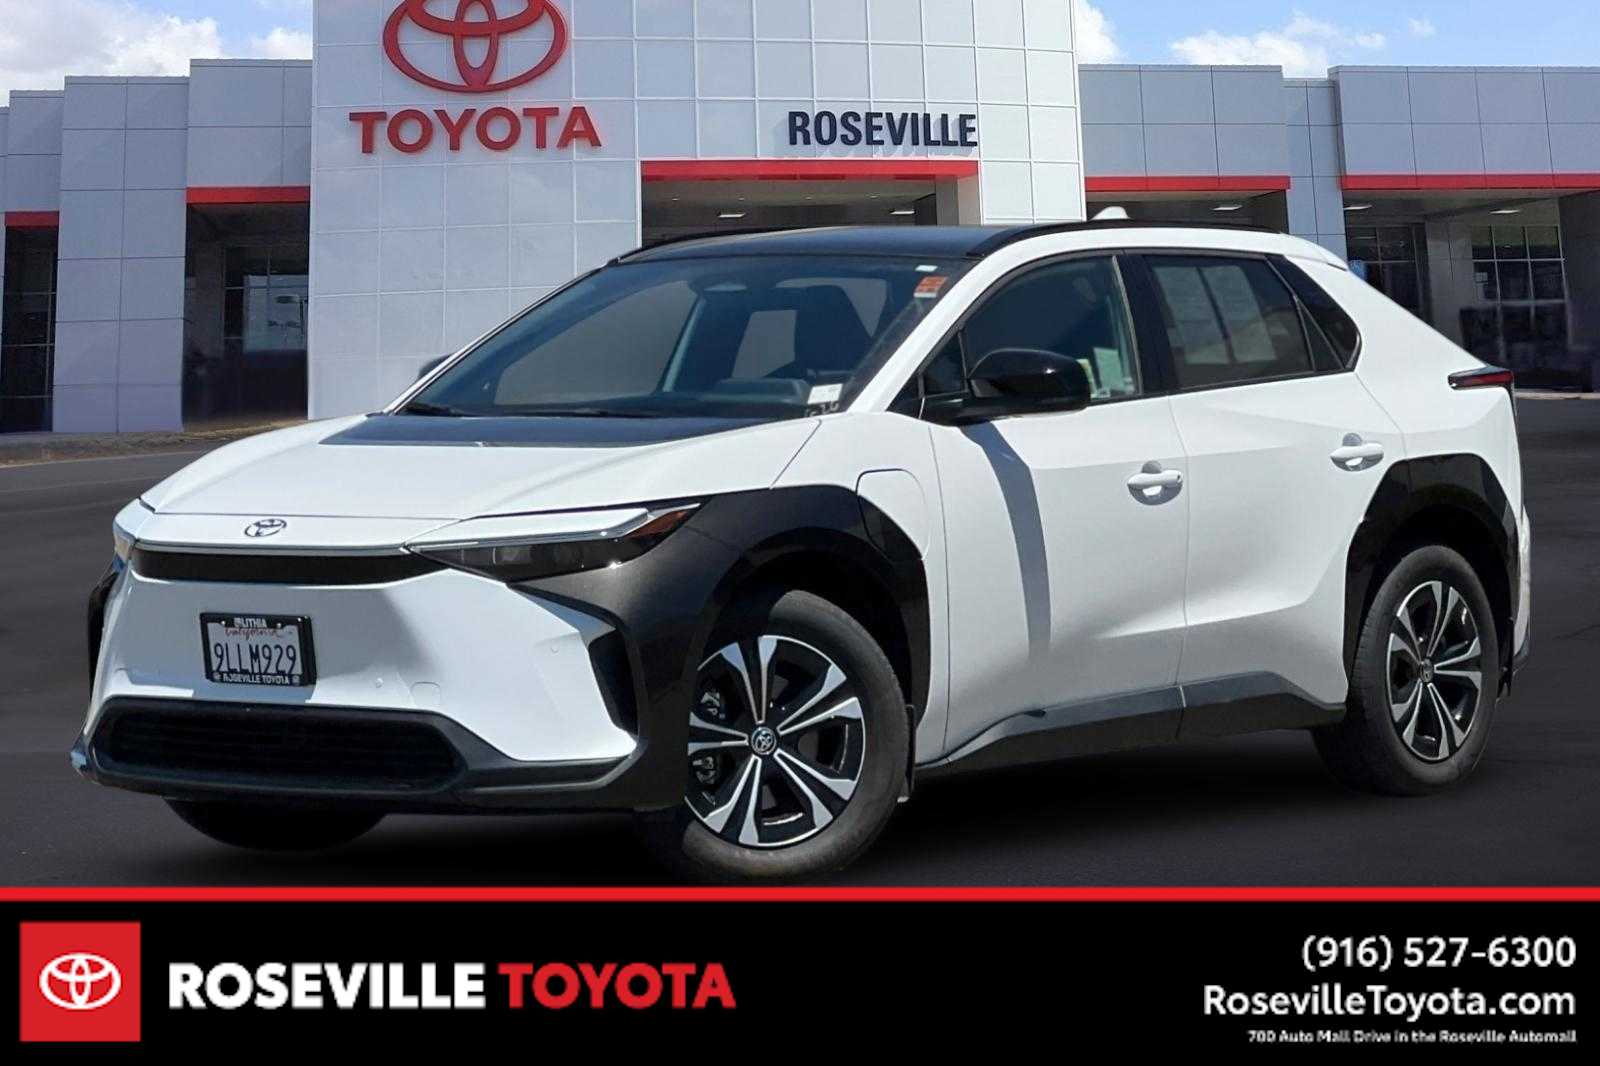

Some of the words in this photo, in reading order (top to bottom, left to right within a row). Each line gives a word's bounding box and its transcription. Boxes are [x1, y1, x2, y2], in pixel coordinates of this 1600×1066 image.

[349, 106, 602, 154] TOYOTA
[788, 111, 978, 147] ROSEVILLE
[214, 643, 296, 675] 9LLM929
[262, 675, 290, 685] TOYOTA
